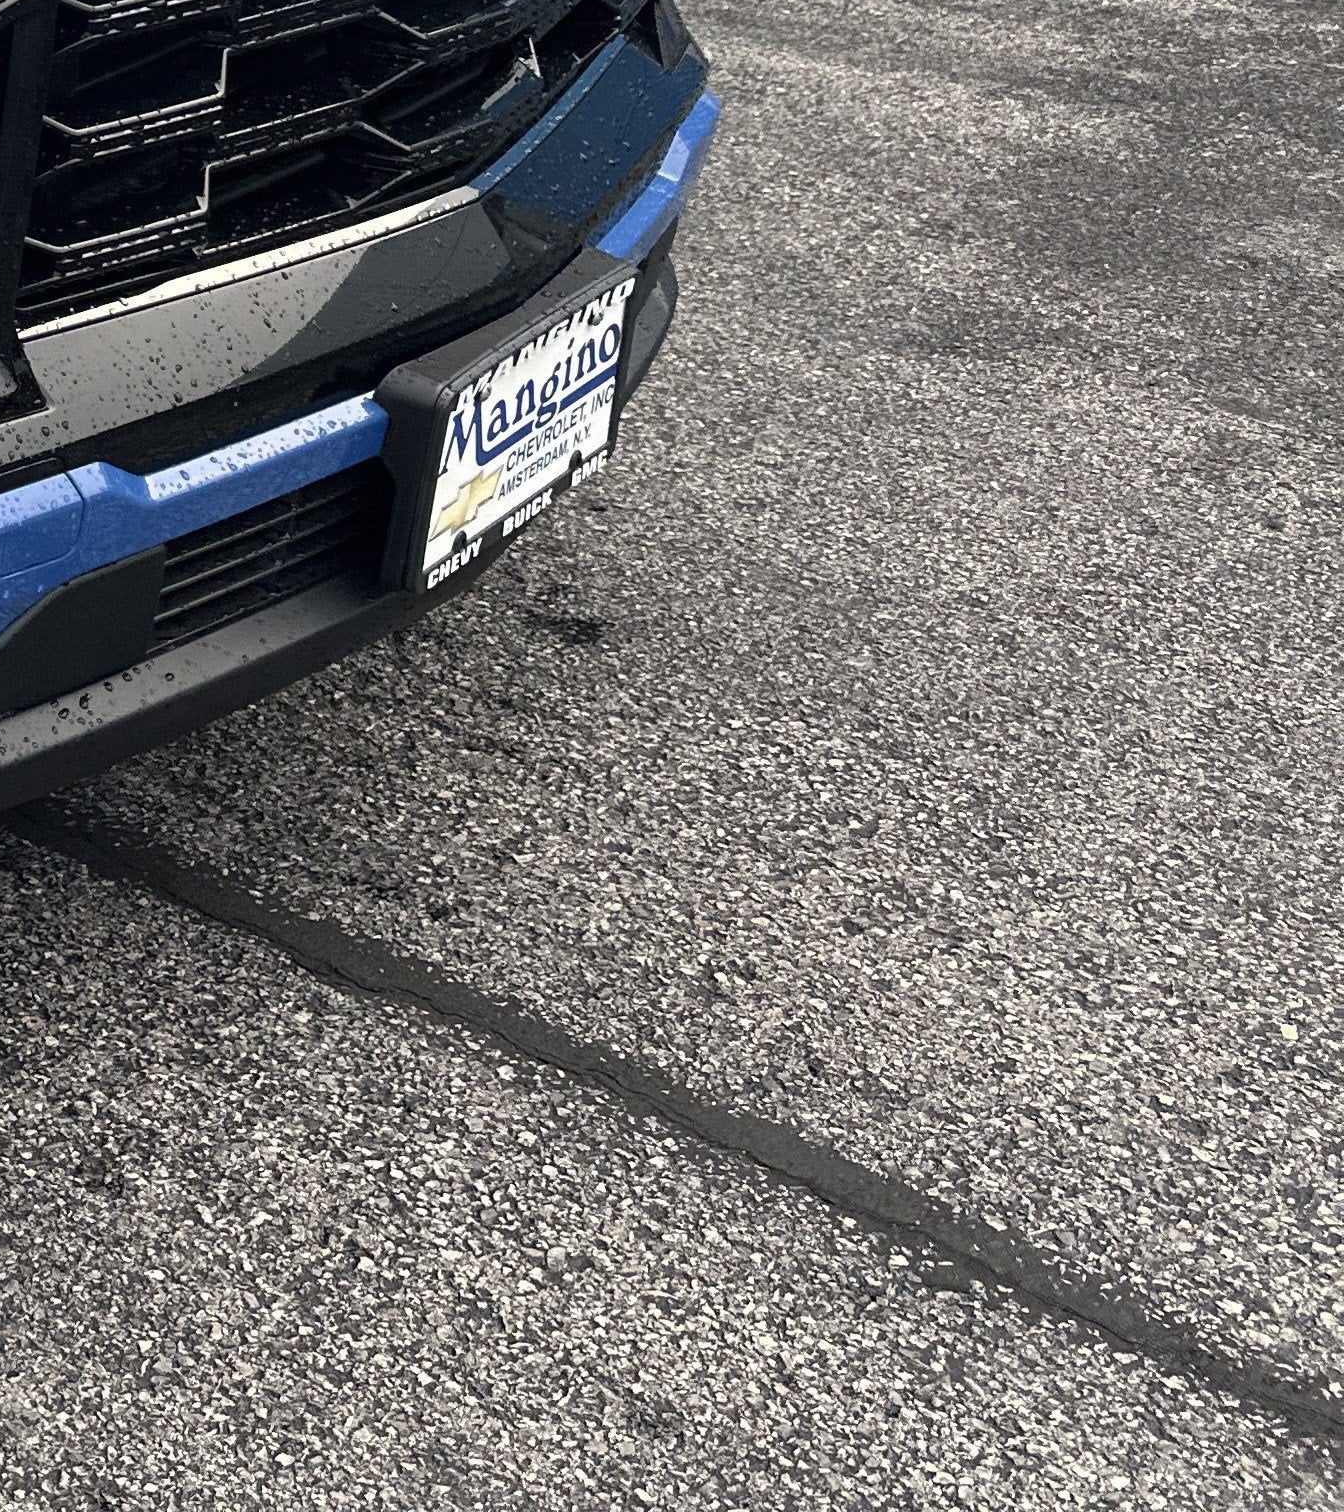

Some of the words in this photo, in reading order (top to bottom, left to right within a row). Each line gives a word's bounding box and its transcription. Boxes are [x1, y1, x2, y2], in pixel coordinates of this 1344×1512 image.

[439, 323, 621, 476] Mangino
[427, 538, 483, 590] CHEVY
[502, 488, 554, 538] BUICK
[571, 449, 610, 487] GMC
